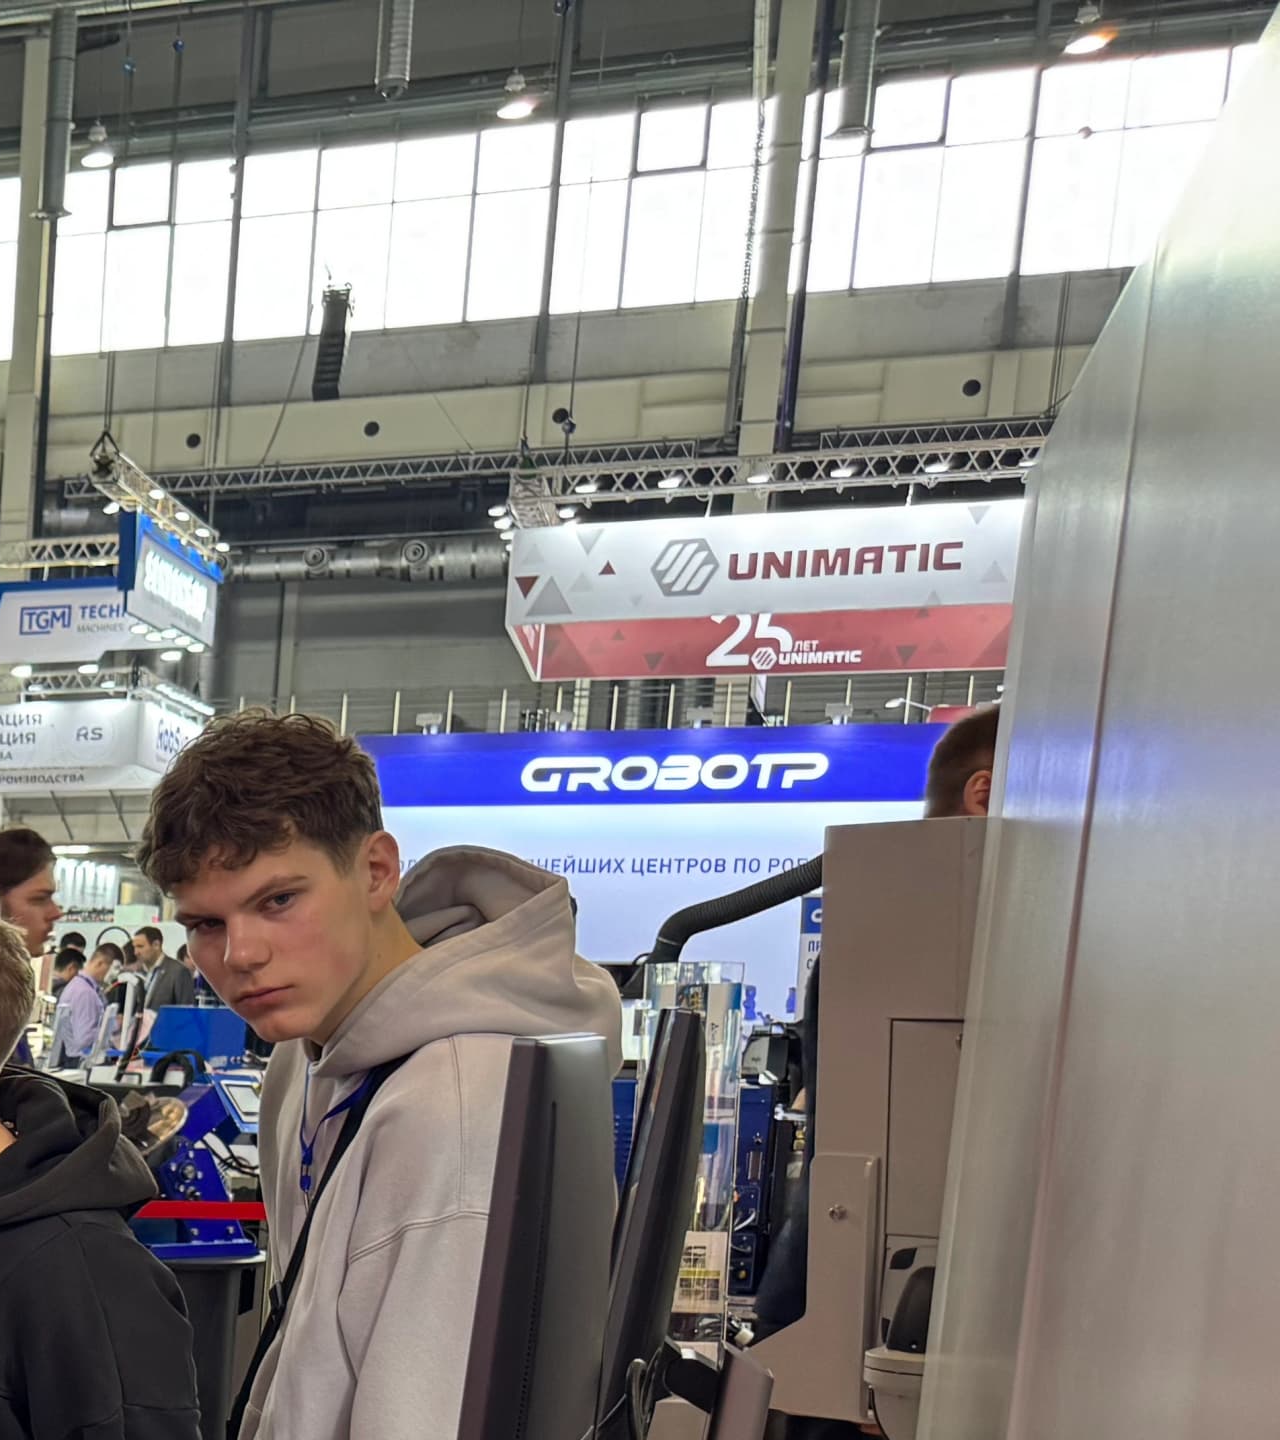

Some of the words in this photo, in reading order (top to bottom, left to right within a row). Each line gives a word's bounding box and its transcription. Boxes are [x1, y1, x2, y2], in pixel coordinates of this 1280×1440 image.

[728, 541, 964, 581] UNIMATIC
[24, 610, 67, 630] TGM
[79, 604, 125, 619] TECH
[706, 613, 793, 667] 25
[793, 640, 819, 652] ЛЕТ
[779, 650, 862, 665] UNIMATIC
[631, 857, 726, 876] ЦЕНТРОВ
[734, 857, 760, 873] ПО
